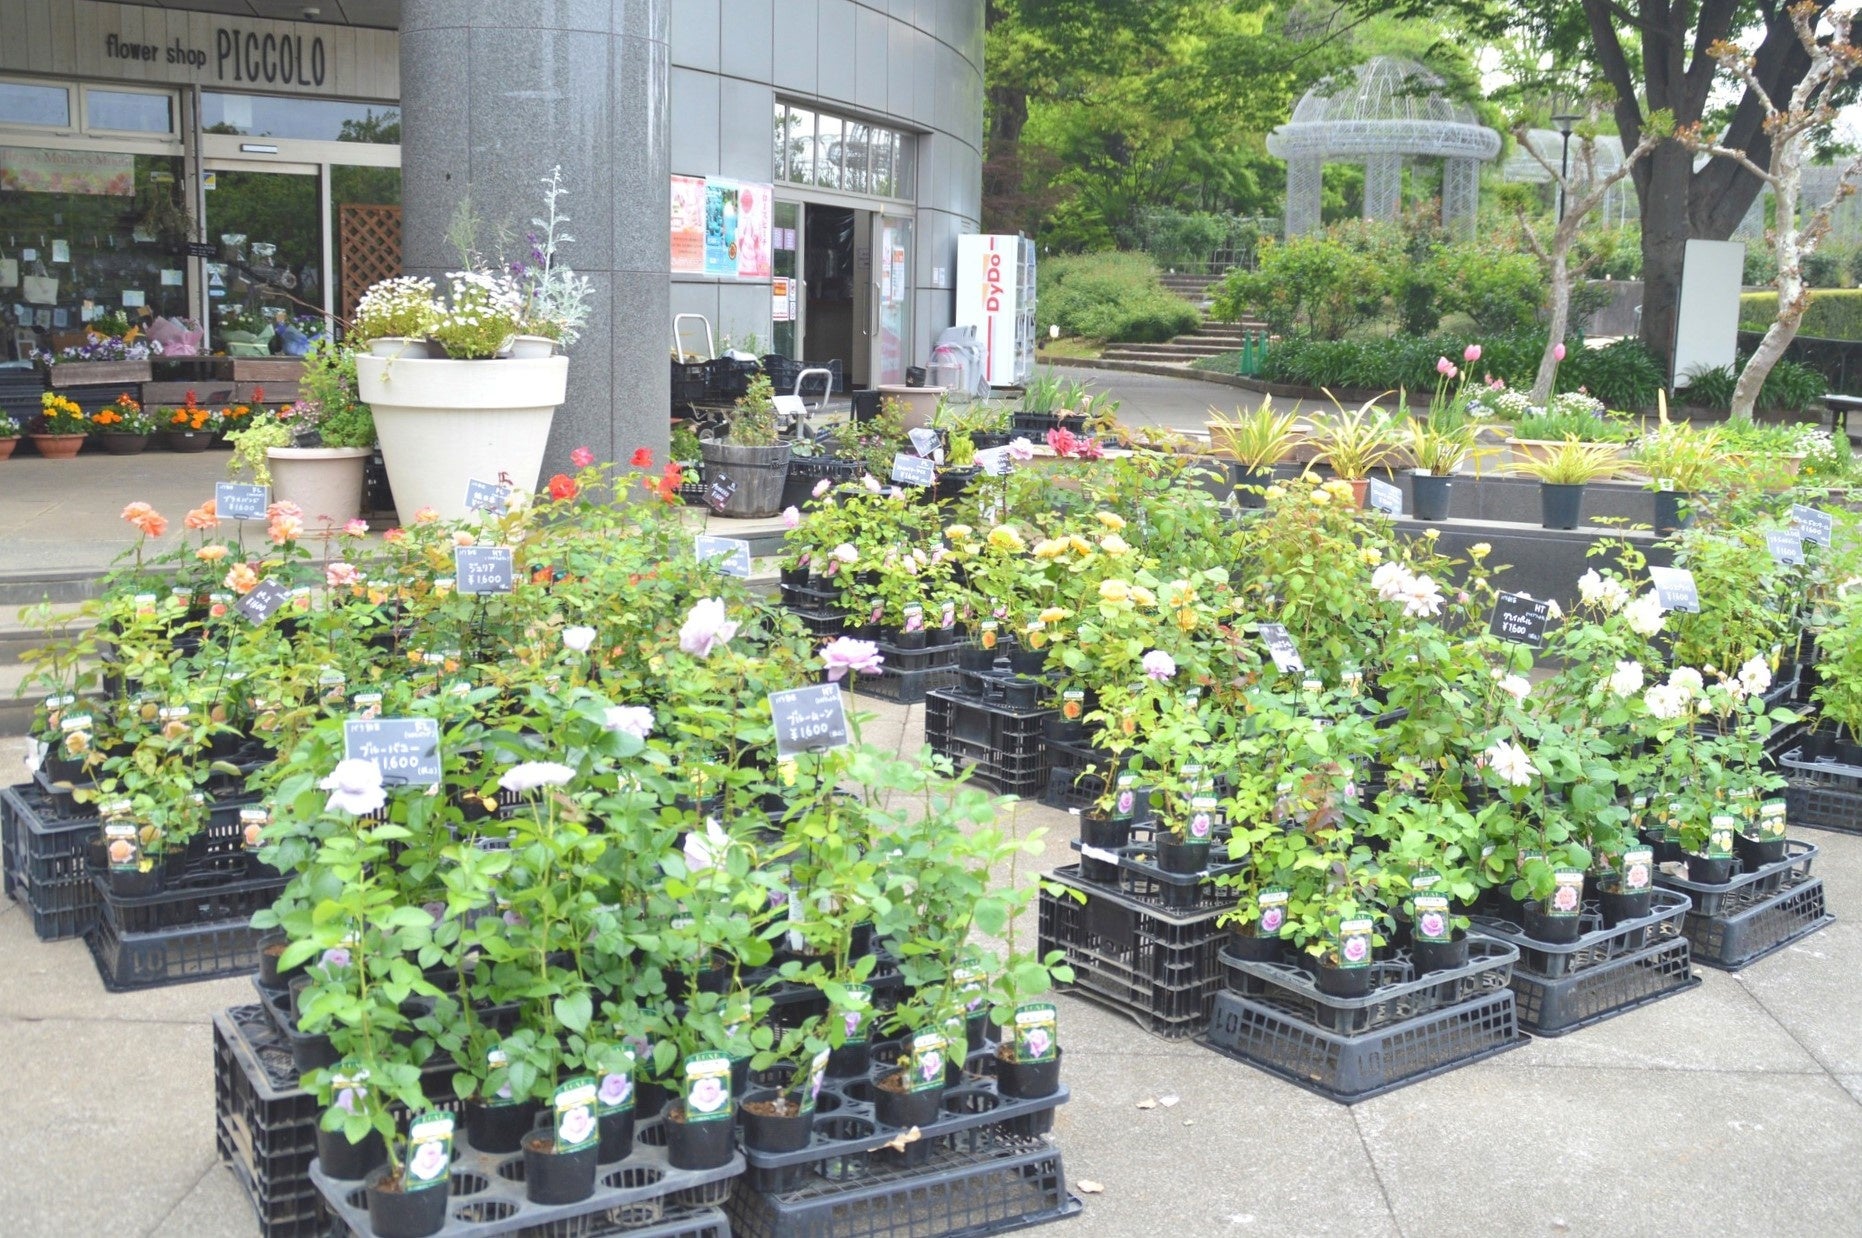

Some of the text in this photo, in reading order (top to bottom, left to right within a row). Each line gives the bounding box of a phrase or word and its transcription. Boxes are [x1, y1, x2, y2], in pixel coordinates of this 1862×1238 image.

[105, 28, 325, 87] flower shop PICCOLO
[986, 254, 1005, 312] DyDo
[468, 562, 497, 574] ジュリア
[1534, 603, 1547, 614] HT
[786, 709, 835, 727] ブルームーン
